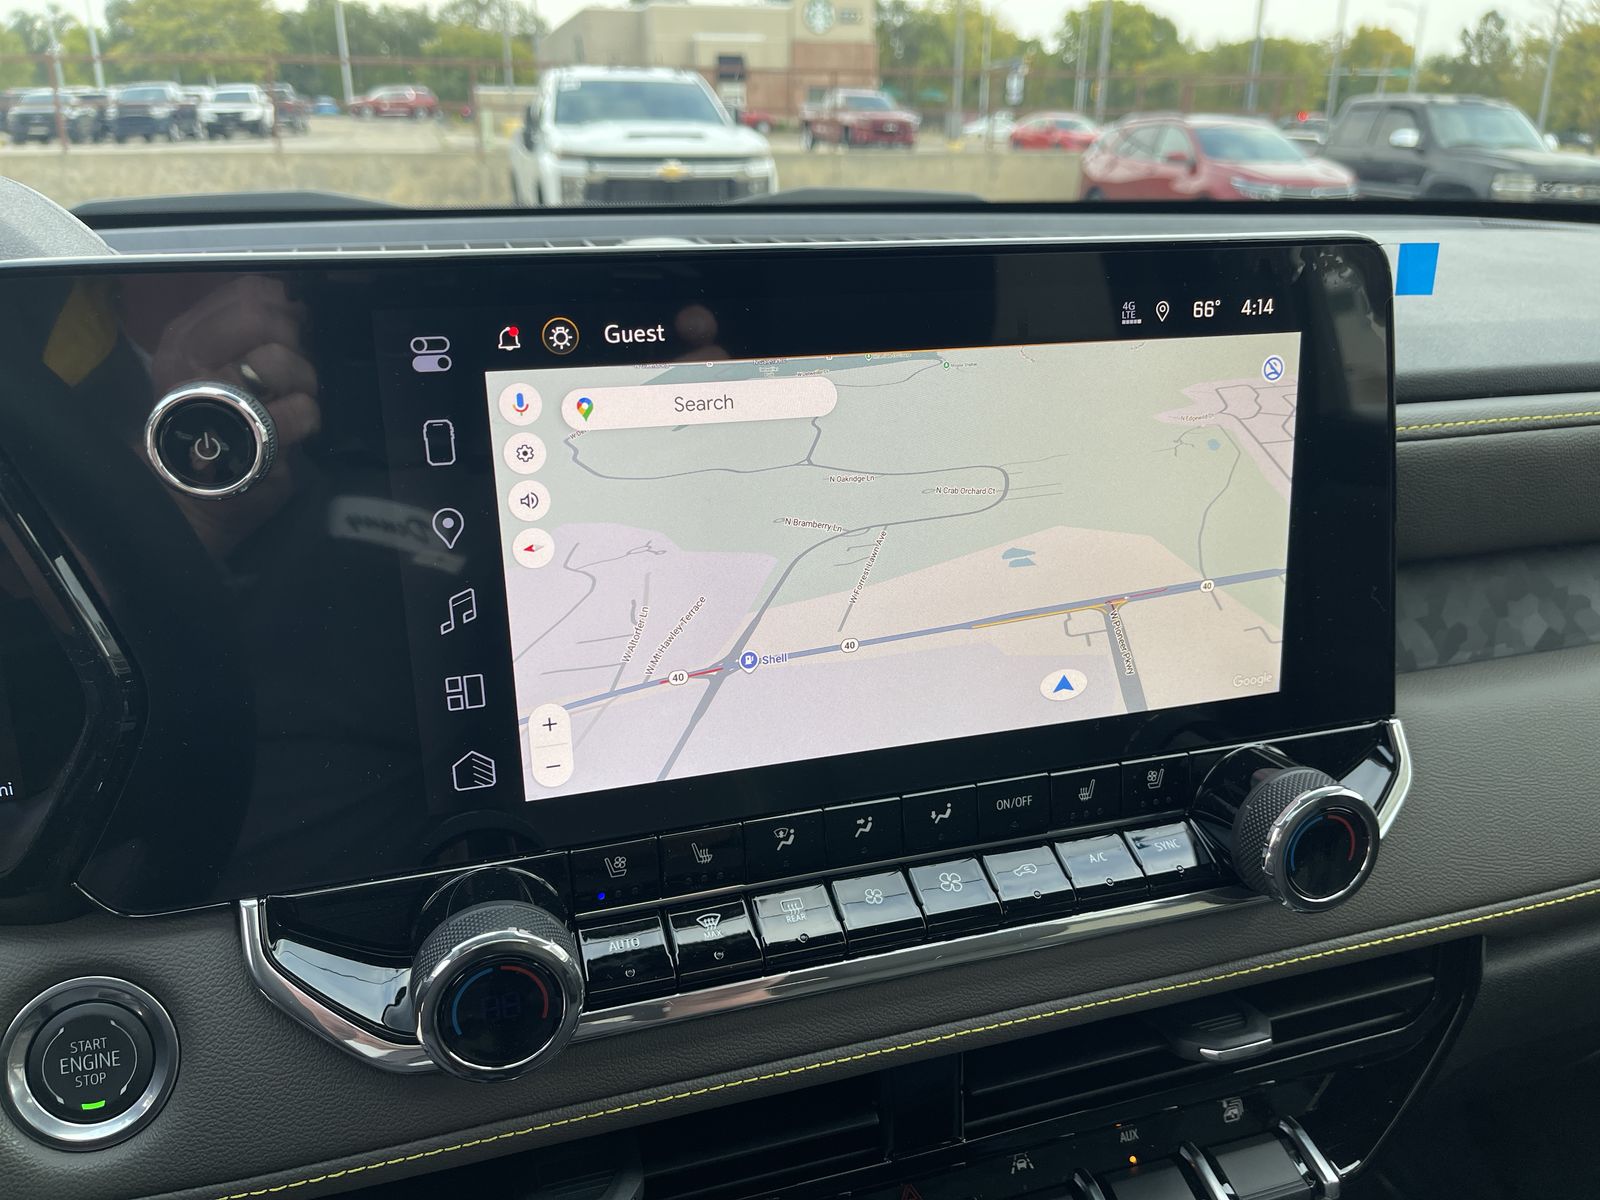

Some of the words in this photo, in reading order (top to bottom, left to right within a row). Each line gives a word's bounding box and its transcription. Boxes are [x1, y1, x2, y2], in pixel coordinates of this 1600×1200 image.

[1122, 301, 1136, 311] 4G
[1240, 298, 1275, 317] 4:14
[1121, 310, 1136, 320] LTE
[604, 324, 666, 344] Guest
[673, 393, 735, 413] Search
[836, 475, 866, 484] Oakridge
[936, 486, 942, 494] N
[943, 486, 959, 495] Crab
[960, 487, 987, 495] Orchard
[987, 487, 997, 495] Ct
[784, 517, 792, 526] N
[793, 518, 832, 532] Bramberry
[832, 524, 843, 533] Ln
[866, 545, 880, 568] Lawn
[876, 530, 888, 547] Ave
[1202, 582, 1212, 590] 40
[657, 623, 685, 654] Hawley
[679, 595, 706, 626] Terrace
[621, 652, 632, 663] W
[630, 617, 646, 654] Altorfer
[639, 606, 649, 619] Ln
[844, 640, 856, 650] 40
[1113, 619, 1128, 653] Pioneer
[1123, 651, 1135, 675] Pkwy
[762, 653, 788, 665] Shell
[672, 672, 685, 683] 40
[1232, 672, 1273, 688] Google
[995, 794, 1033, 811] ON/OFF
[1154, 837, 1181, 852] SYNC
[1088, 850, 1107, 864] A/C
[785, 914, 807, 923] REAR
[703, 929, 722, 940] MAX
[608, 936, 641, 953] AUTO
[70, 1036, 107, 1054] START
[60, 1049, 121, 1075] ENGINE
[75, 1072, 107, 1088] STOP
[1119, 1129, 1139, 1143] AUX
